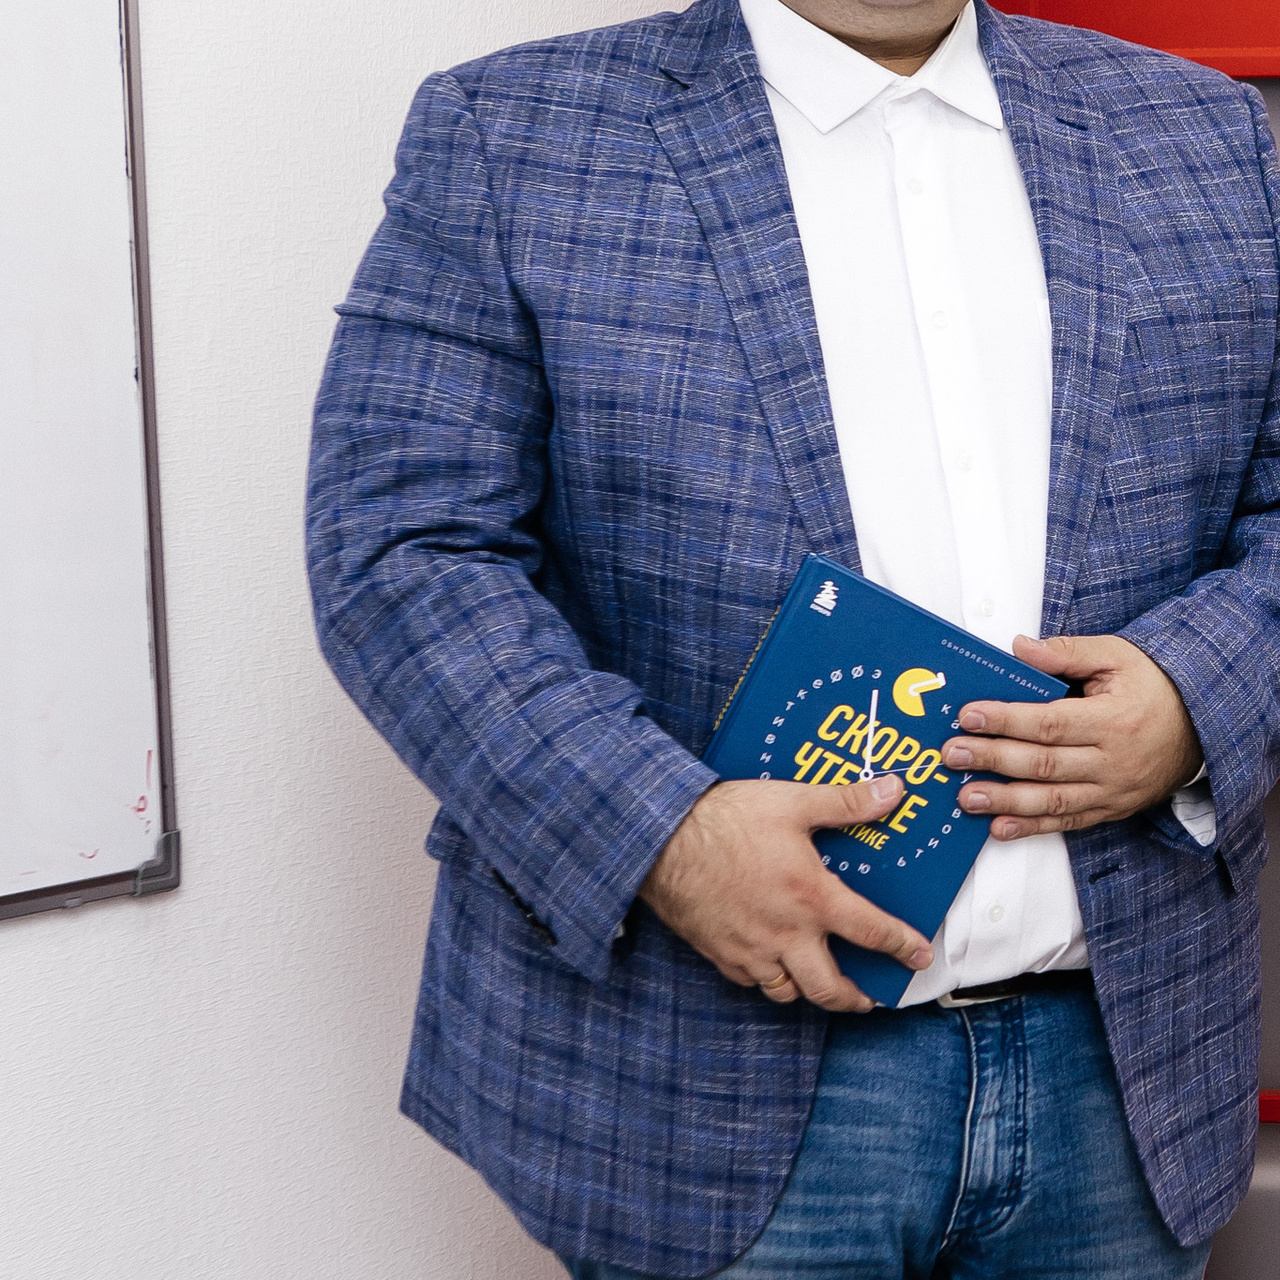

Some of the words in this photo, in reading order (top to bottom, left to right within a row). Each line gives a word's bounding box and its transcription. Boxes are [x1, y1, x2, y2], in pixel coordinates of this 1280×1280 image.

[940, 638, 1006, 675] ОБНОВЛЕННОЕ
[1008, 672, 1051, 698] ИЗДАНИЕ
[817, 704, 949, 786] СКОРО-
[793, 741, 929, 834] ЧТЕЕ
[897, 771, 973, 867] увоить
[821, 854, 872, 875] вою
